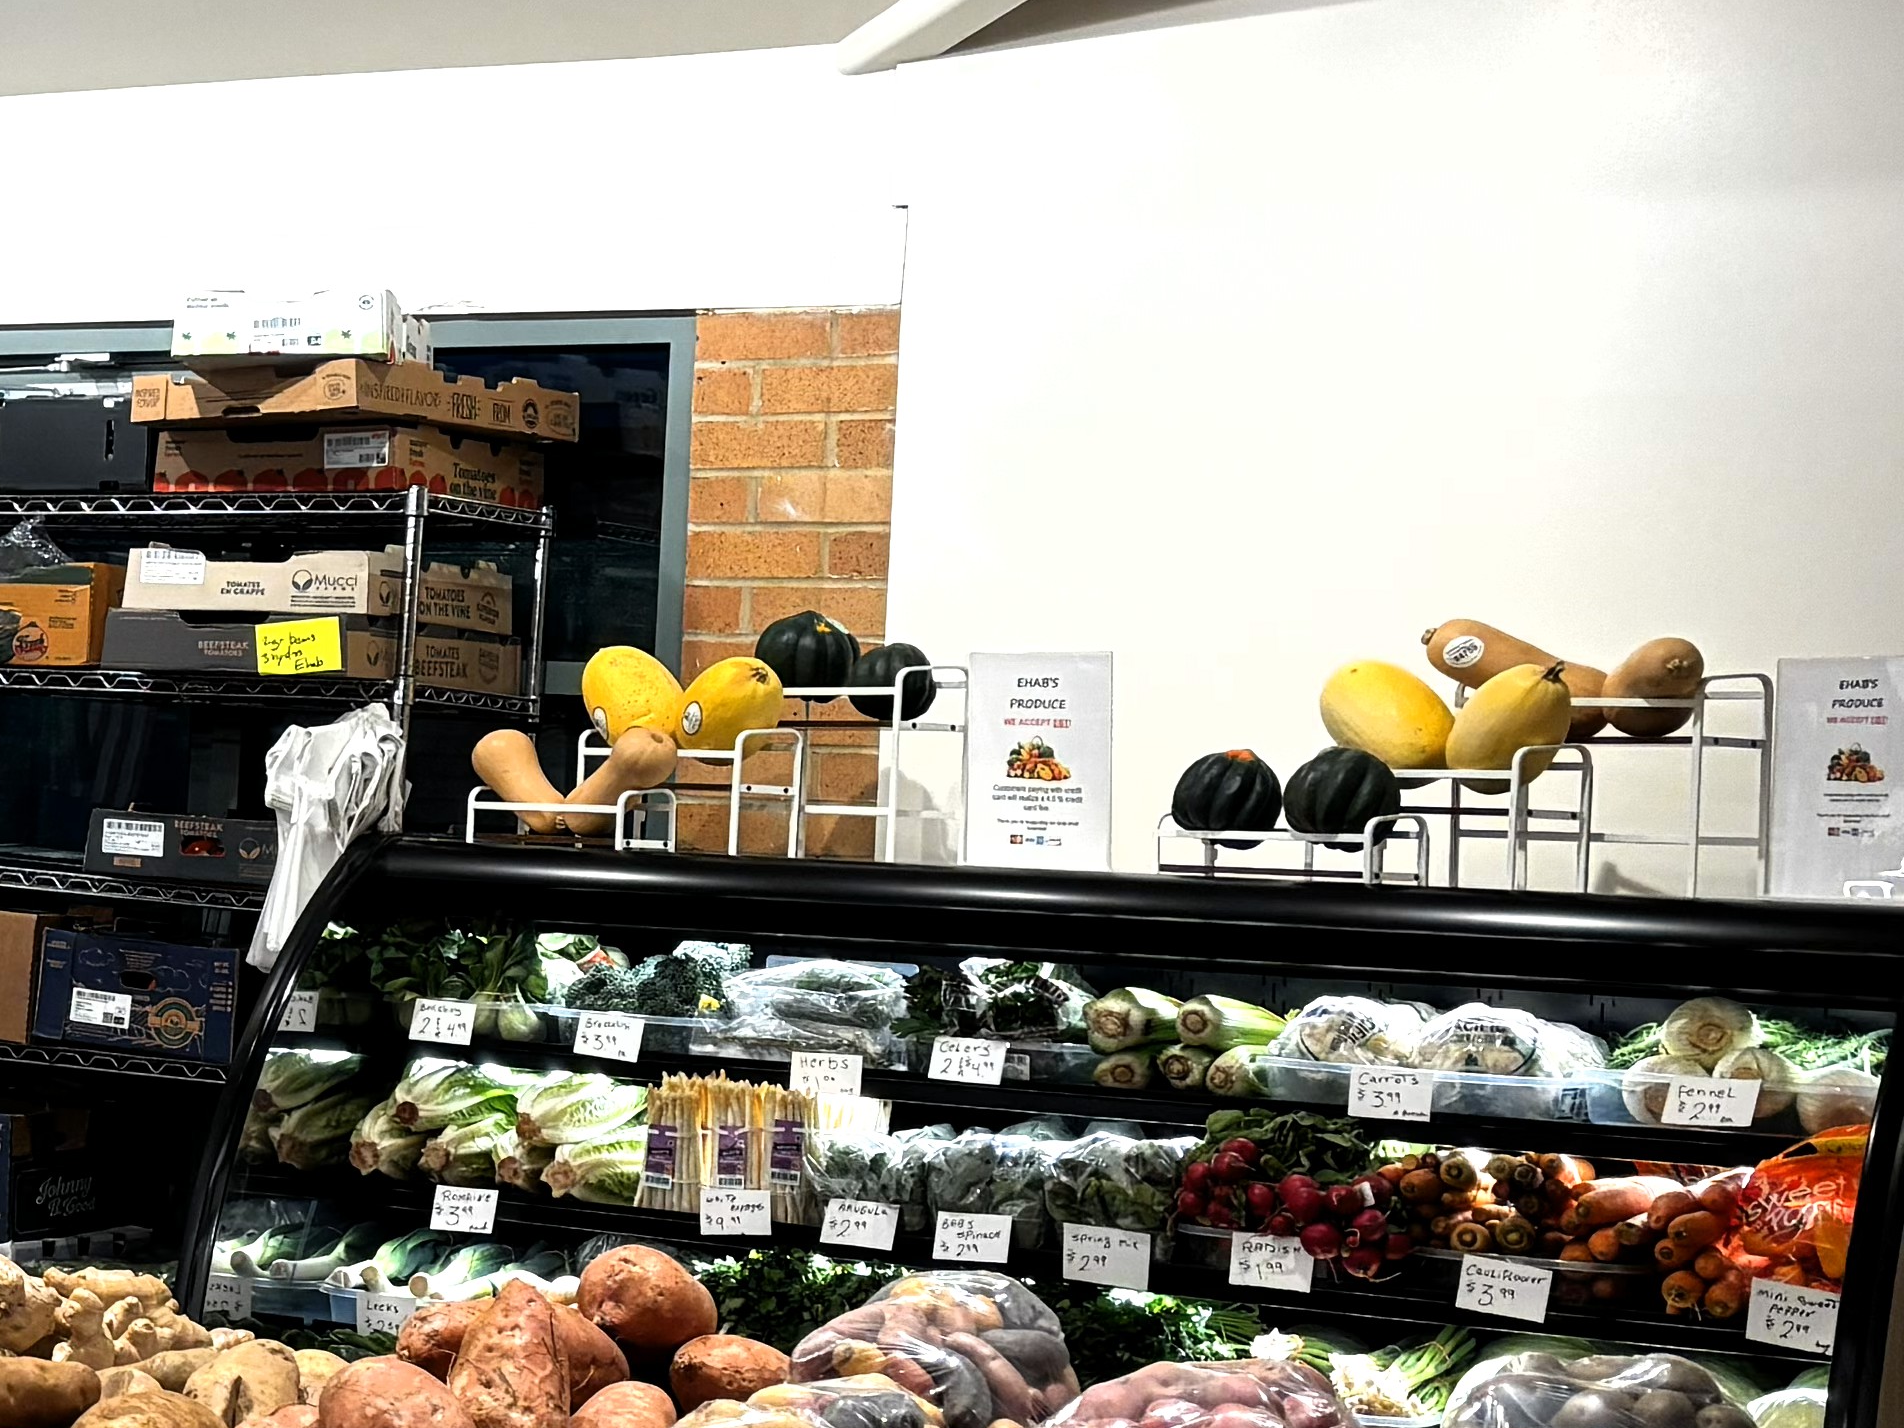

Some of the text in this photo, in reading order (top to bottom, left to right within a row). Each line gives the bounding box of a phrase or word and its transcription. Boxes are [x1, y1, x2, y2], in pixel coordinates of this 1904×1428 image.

[452, 461, 497, 484] Tomatoes
[462, 481, 478, 497] the
[313, 573, 358, 587] Mucci
[424, 586, 465, 603] TOMATOES
[418, 602, 432, 616] ON
[433, 603, 450, 618] THE
[450, 605, 471, 620] VINE
[414, 660, 469, 679] BEEFSTEAK
[1009, 698, 1066, 710] PRODUCE
[1831, 698, 1884, 709] PRODUCE
[418, 1017, 431, 1034] 2
[799, 1056, 849, 1070] Herbs
[940, 1058, 952, 1074] 2
